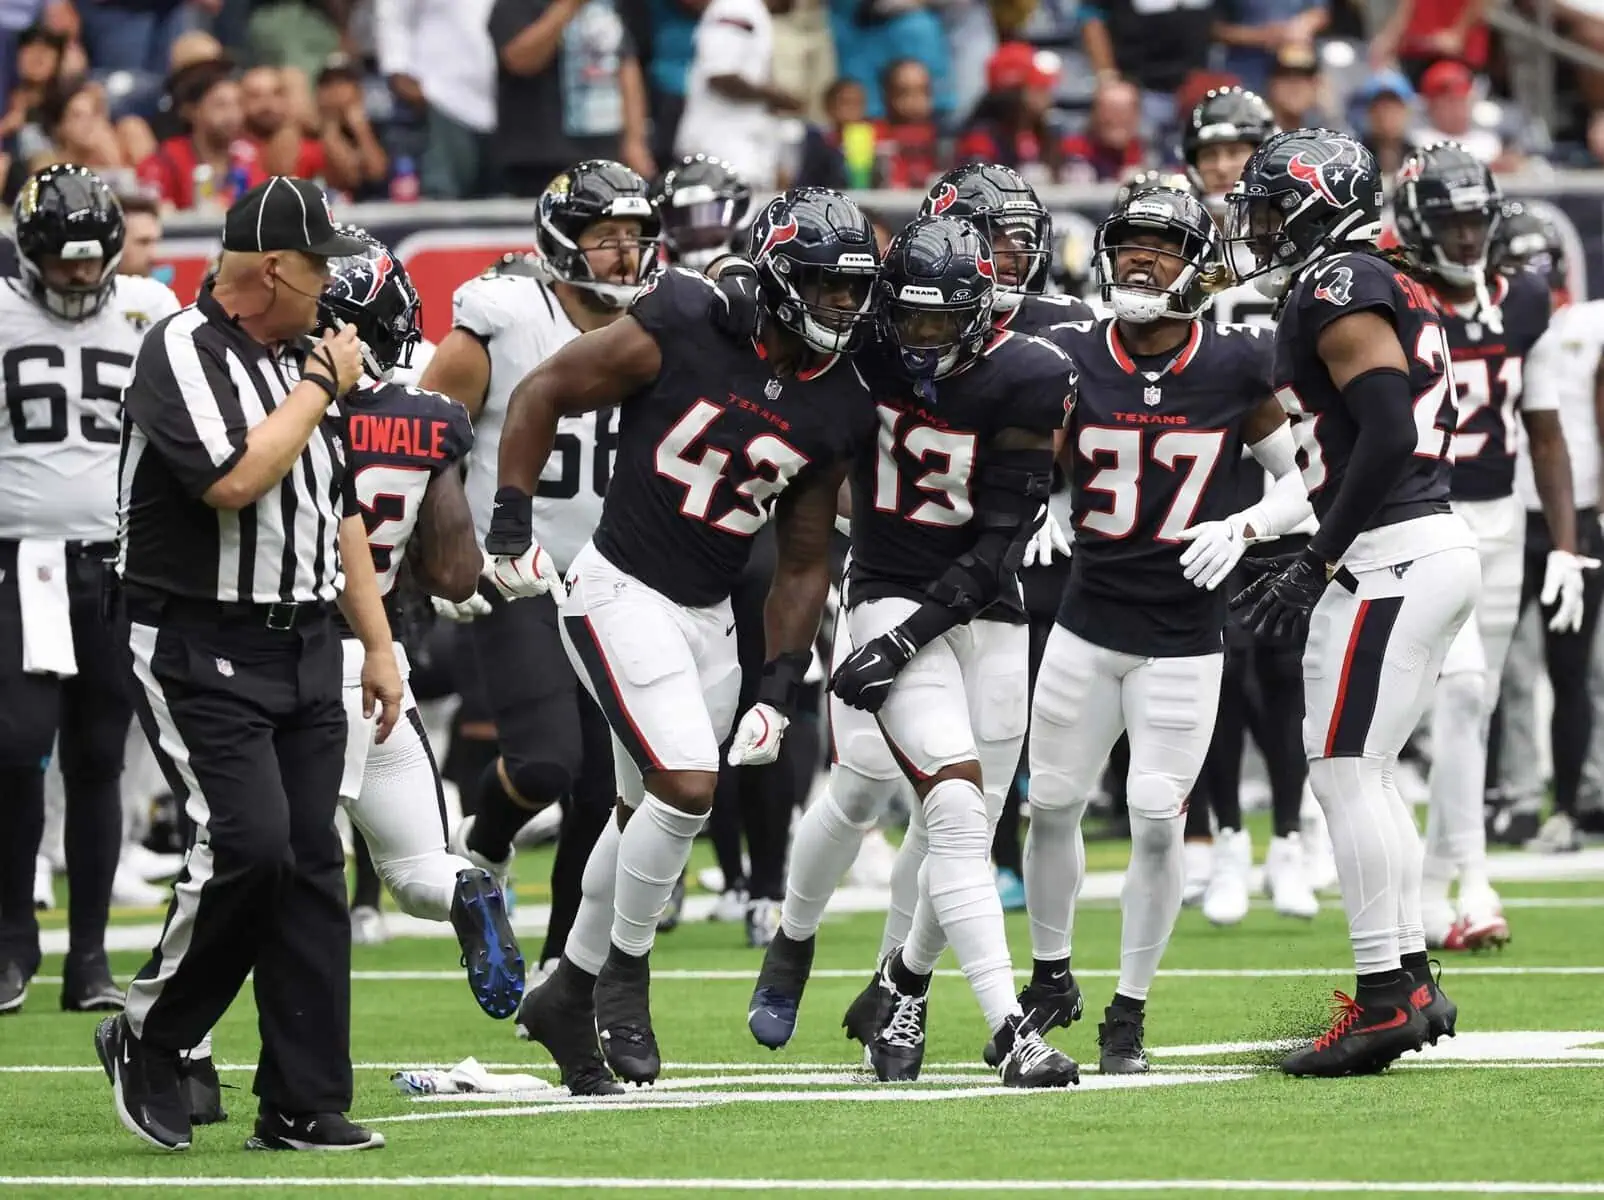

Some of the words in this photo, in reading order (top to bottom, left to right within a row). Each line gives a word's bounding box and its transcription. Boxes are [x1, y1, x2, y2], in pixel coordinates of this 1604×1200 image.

[3, 345, 135, 444] 65
[350, 414, 448, 459] OWALE
[1111, 411, 1188, 424] TEXANS
[656, 398, 812, 537] 43
[873, 401, 978, 528] 13
[1079, 424, 1228, 544] 37
